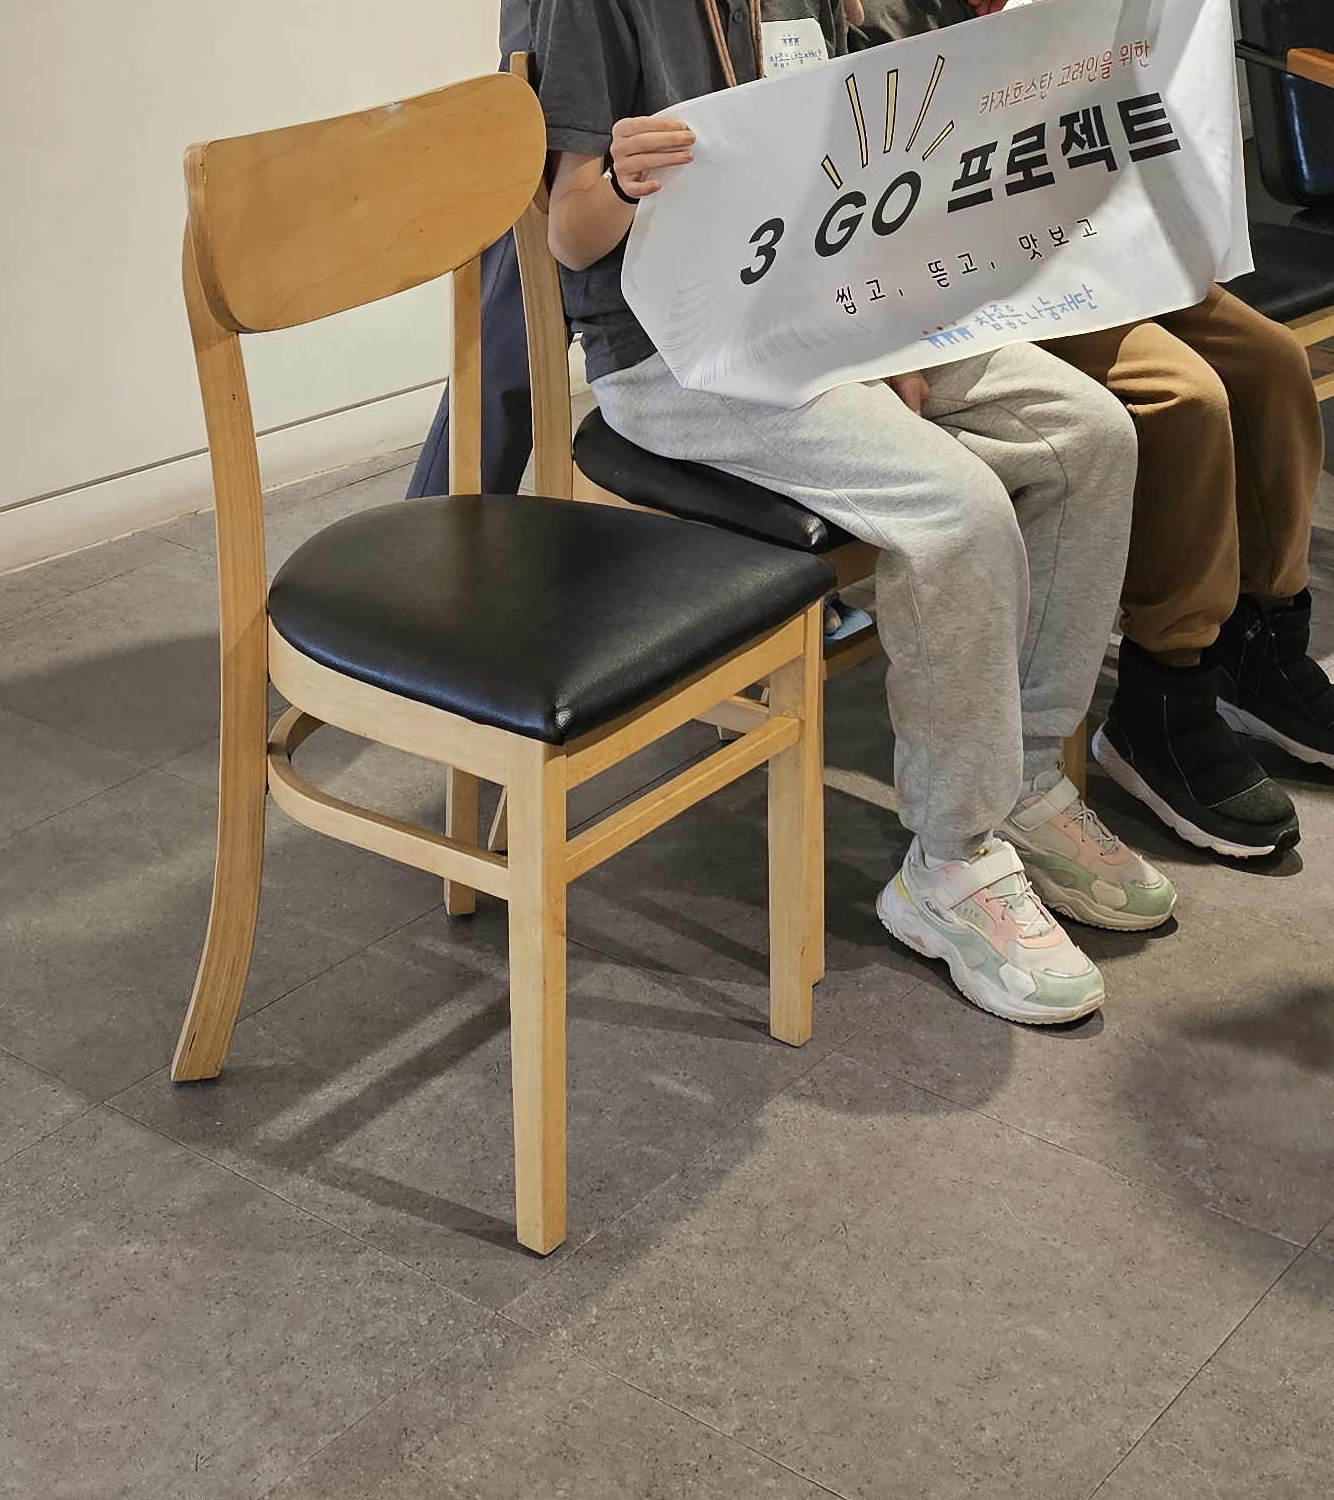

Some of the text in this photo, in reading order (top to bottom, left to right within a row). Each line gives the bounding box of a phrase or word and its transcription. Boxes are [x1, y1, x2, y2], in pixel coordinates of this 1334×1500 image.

[769, 48, 823, 69] 참좋은나눔재단
[979, 39, 1151, 114] 카자흐스탄 고려인을 위한
[740, 92, 1181, 286] 3 GO 프로젝트
[974, 284, 1098, 331] 참좋은나눔재단
